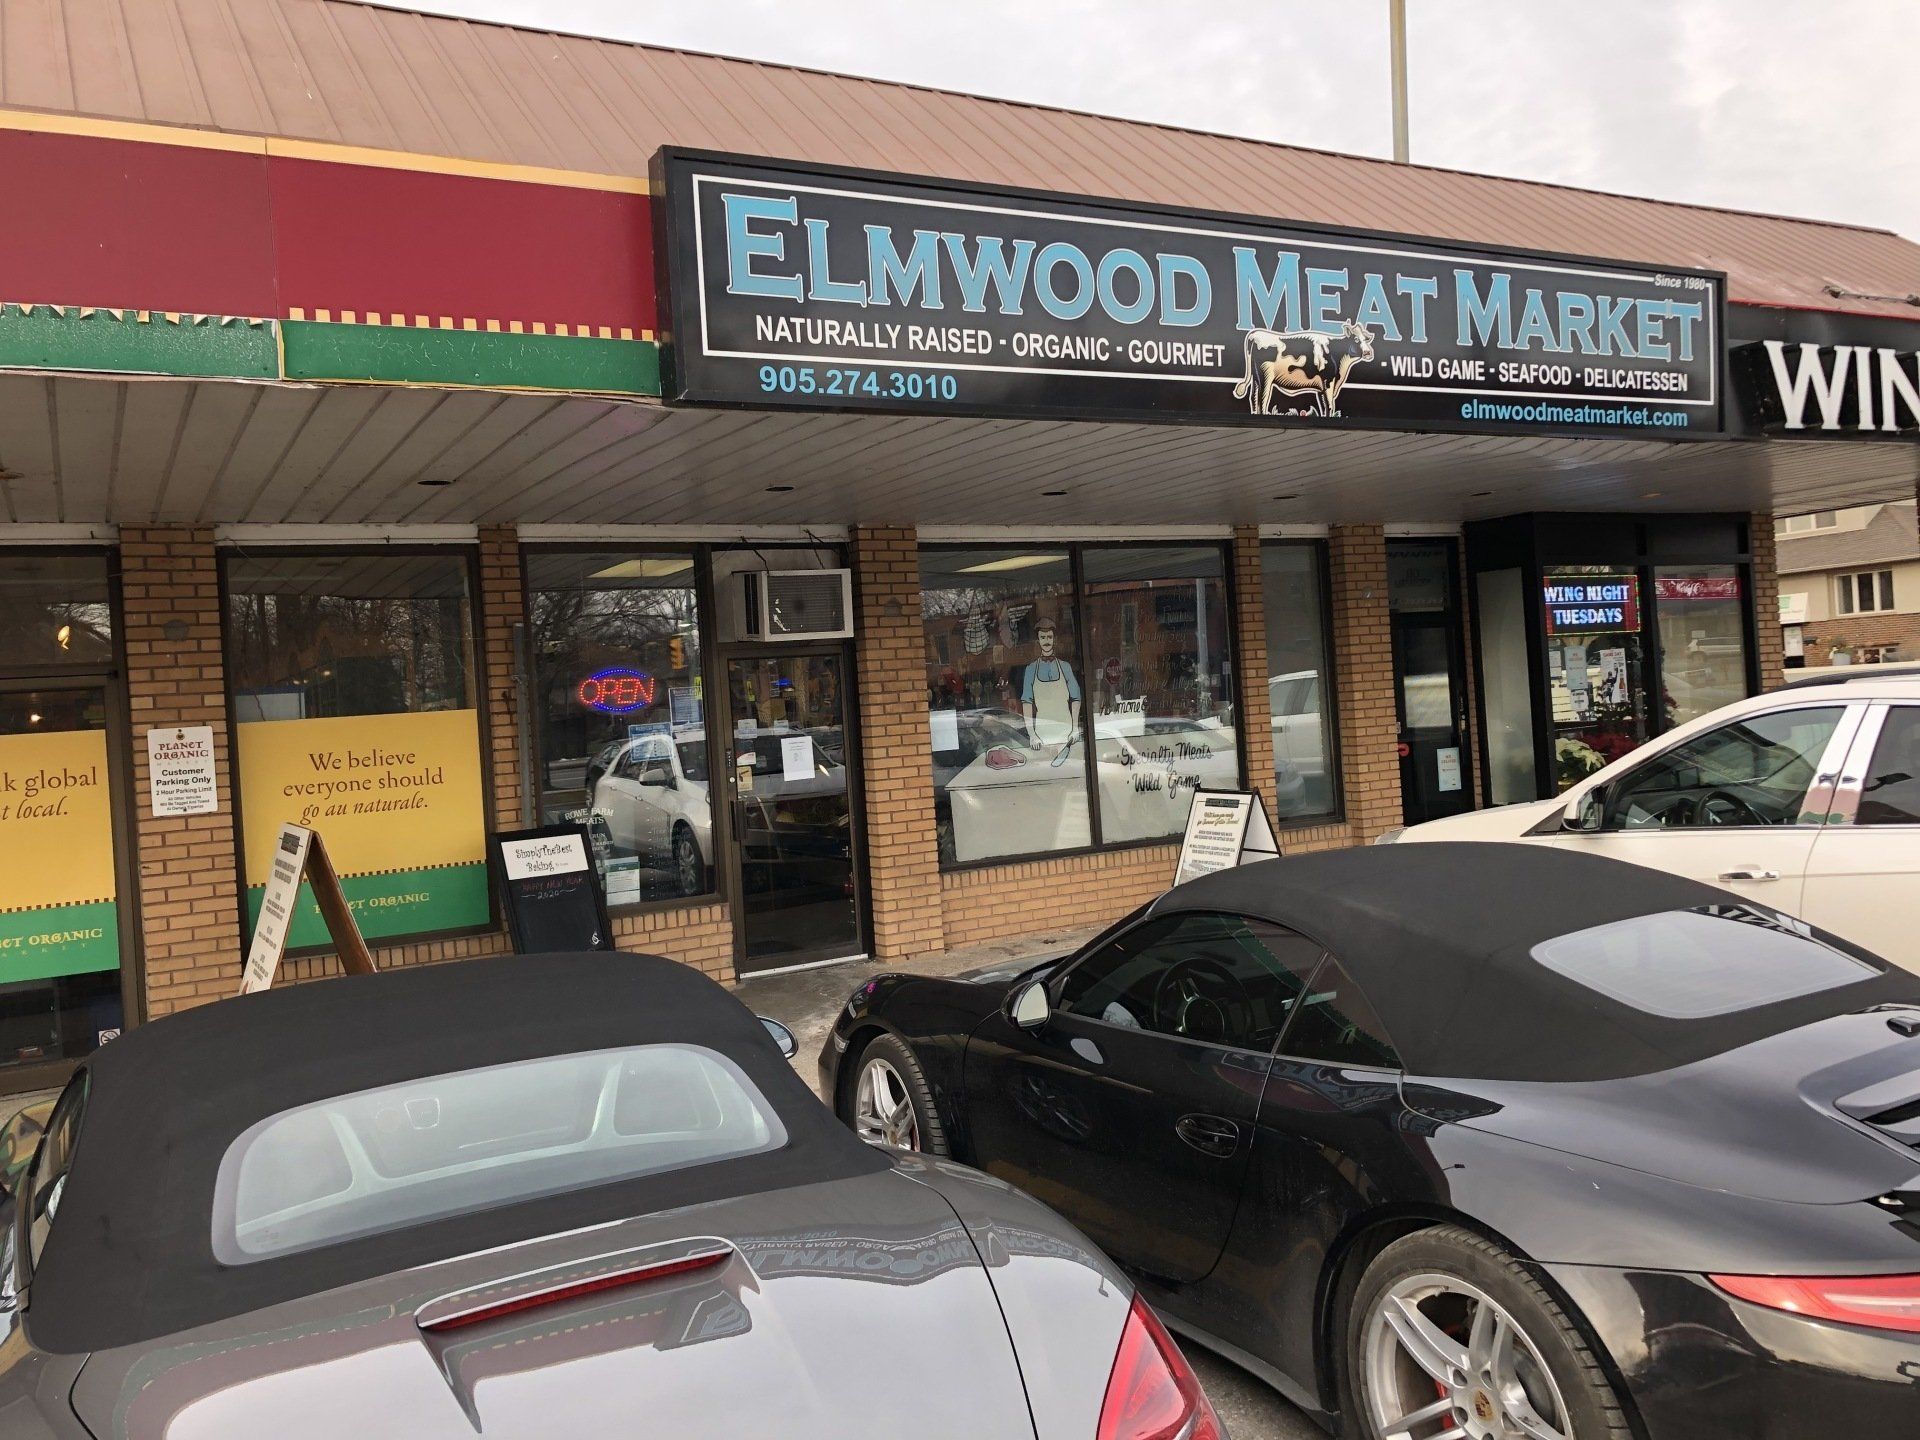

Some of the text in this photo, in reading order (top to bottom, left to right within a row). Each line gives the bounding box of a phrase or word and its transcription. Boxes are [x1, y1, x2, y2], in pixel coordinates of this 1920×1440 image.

[721, 192, 1703, 363] ELMWOOD MEAT MARKET
[1654, 273, 1682, 288] Since
[755, 314, 902, 350] NATURALLY
[908, 325, 993, 355] RAISED
[1012, 332, 1110, 361] ORGANIC
[1128, 339, 1226, 368] GOURMET
[758, 365, 958, 400] 905.274.3010
[1390, 355, 1434, 379] WILD
[1438, 358, 1486, 381] GAME
[1498, 361, 1572, 386] SEAFOOD
[1584, 367, 1689, 392] DELICATESSEN
[1461, 399, 1689, 427] elmwoodmeatmarket.com
[1544, 585, 1630, 602] WING NIGHT
[1553, 607, 1623, 625] TUESDAYS
[580, 678, 655, 704] OPEN
[154, 749, 209, 760] ORGANIC
[158, 741, 203, 750] PLANET
[1175, 742, 1214, 761] Meats
[309, 748, 416, 772] We believe
[24, 766, 97, 798] global
[156, 776, 212, 787] Parking Only
[161, 768, 205, 777] Customer
[283, 766, 444, 801] everyone should
[1132, 770, 1201, 800] Wild Game
[16, 795, 68, 820] local.
[300, 791, 428, 826] go au naturale.
[564, 807, 615, 821] ROWE FARM
[575, 817, 604, 825] MEATS
[526, 861, 555, 872] Baking
[369, 892, 430, 907] ORGANIC
[28, 928, 103, 946] ORGANIC
